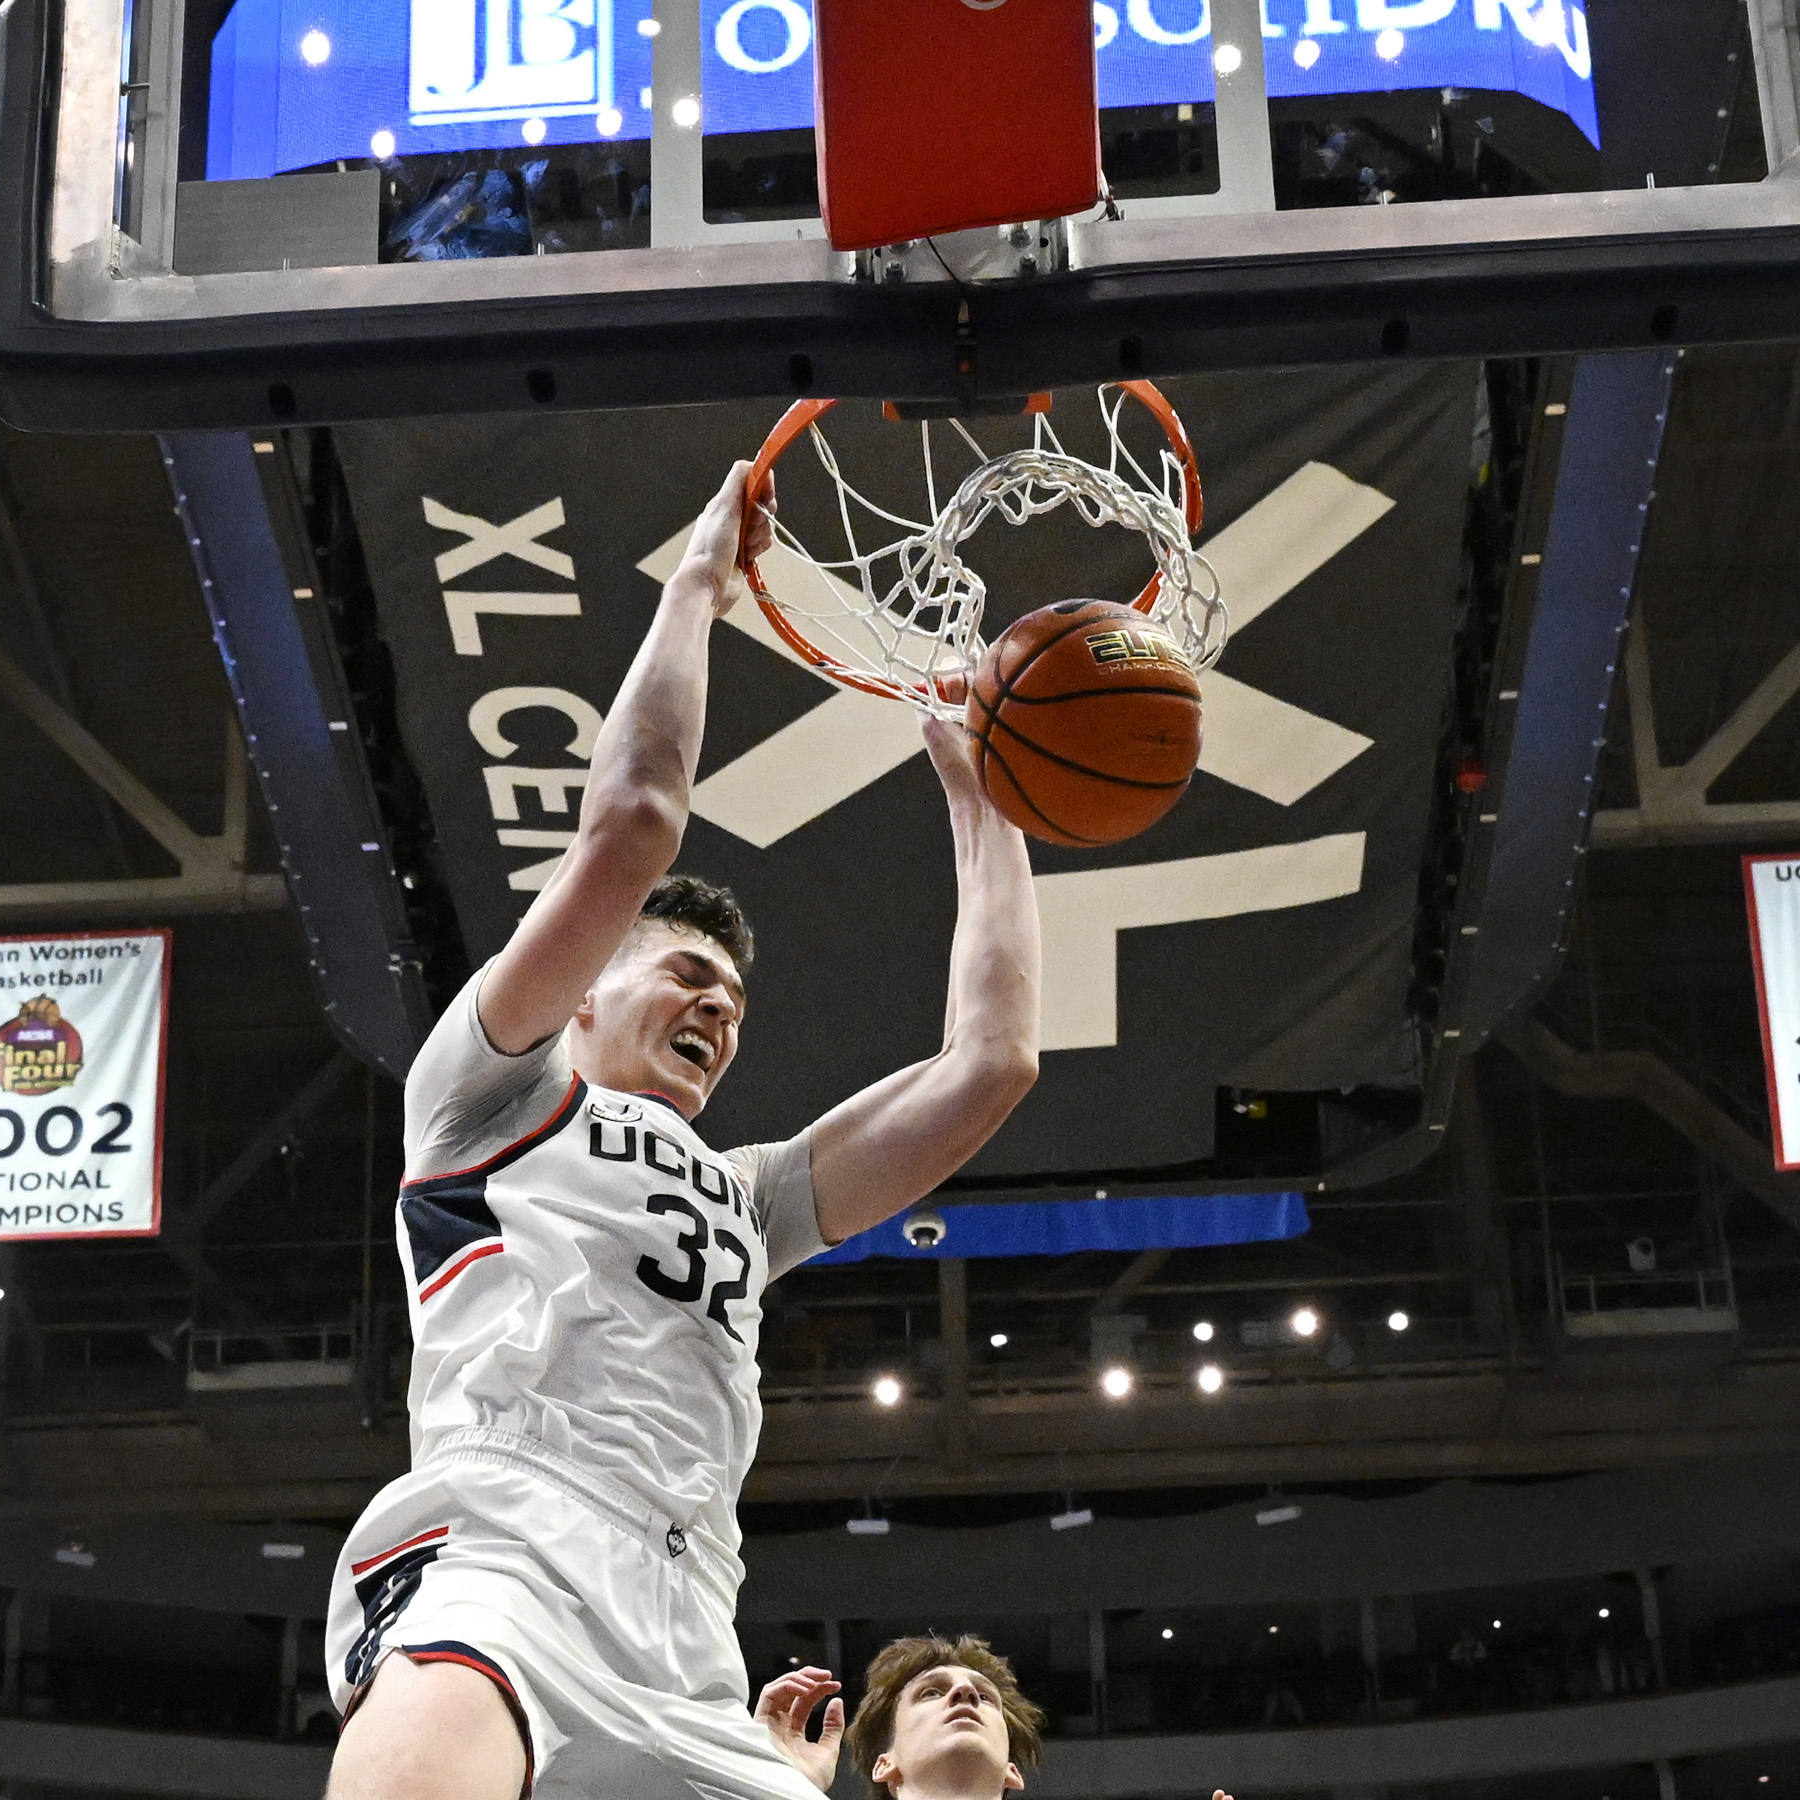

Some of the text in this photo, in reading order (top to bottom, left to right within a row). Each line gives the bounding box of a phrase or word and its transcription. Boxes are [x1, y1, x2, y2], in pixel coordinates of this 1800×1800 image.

[422, 496, 603, 892] XL CEN
[29, 940, 142, 963] Women's
[636, 1193, 752, 1346] 32
